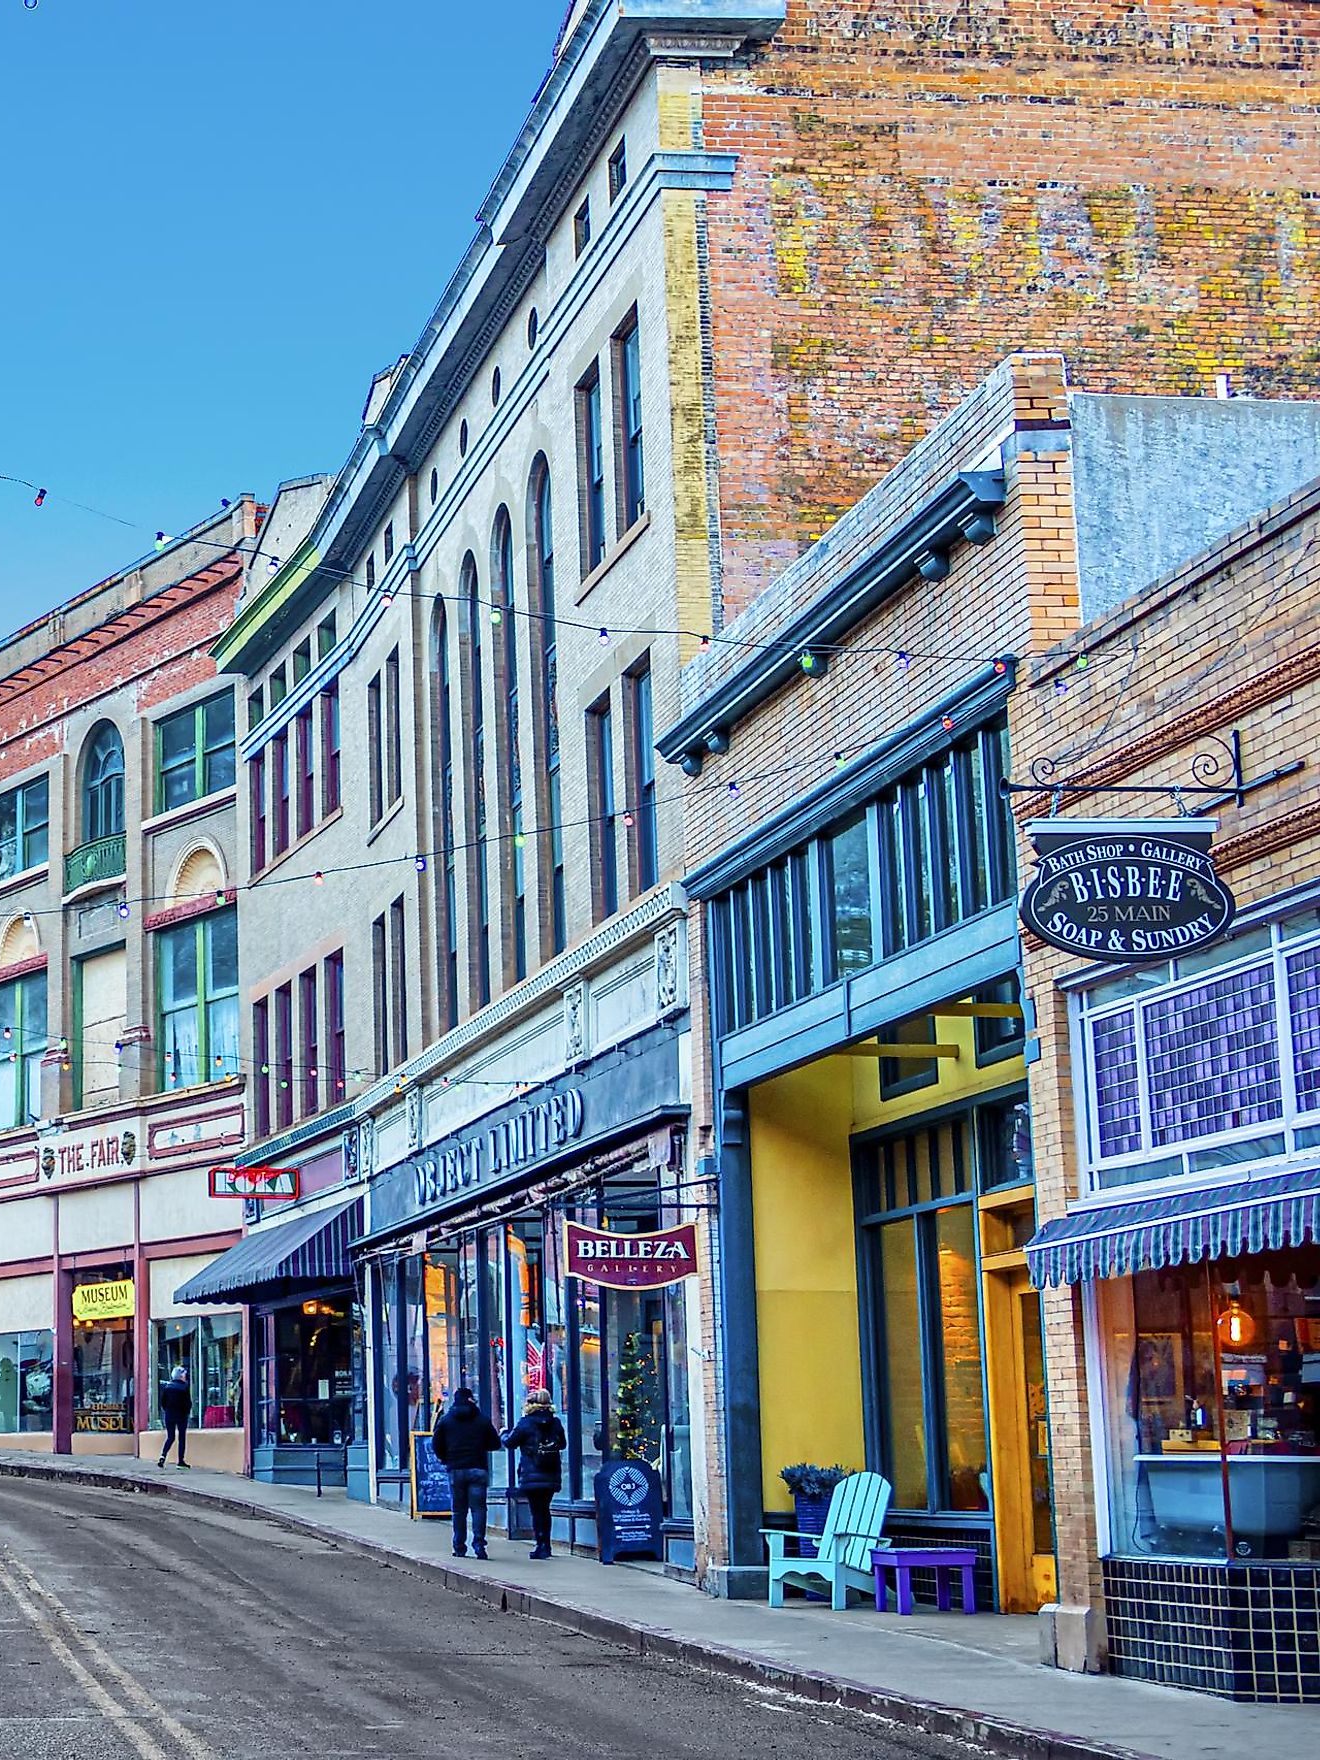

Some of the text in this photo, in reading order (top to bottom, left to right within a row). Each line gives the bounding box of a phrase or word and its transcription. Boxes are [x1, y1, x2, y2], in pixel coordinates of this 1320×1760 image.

[1047, 841, 1205, 873] BATH SHOP GALLERY
[1087, 905, 1171, 923] 25 MAIN
[1047, 911, 1215, 951] SOAP & SUNDRY
[415, 1088, 583, 1206] OBJECT LIMITED
[215, 1171, 294, 1193] ROKA
[576, 1239, 690, 1259] BELLEZA
[587, 1264, 678, 1273] GALLERY
[81, 1285, 128, 1304] MUSEUM
